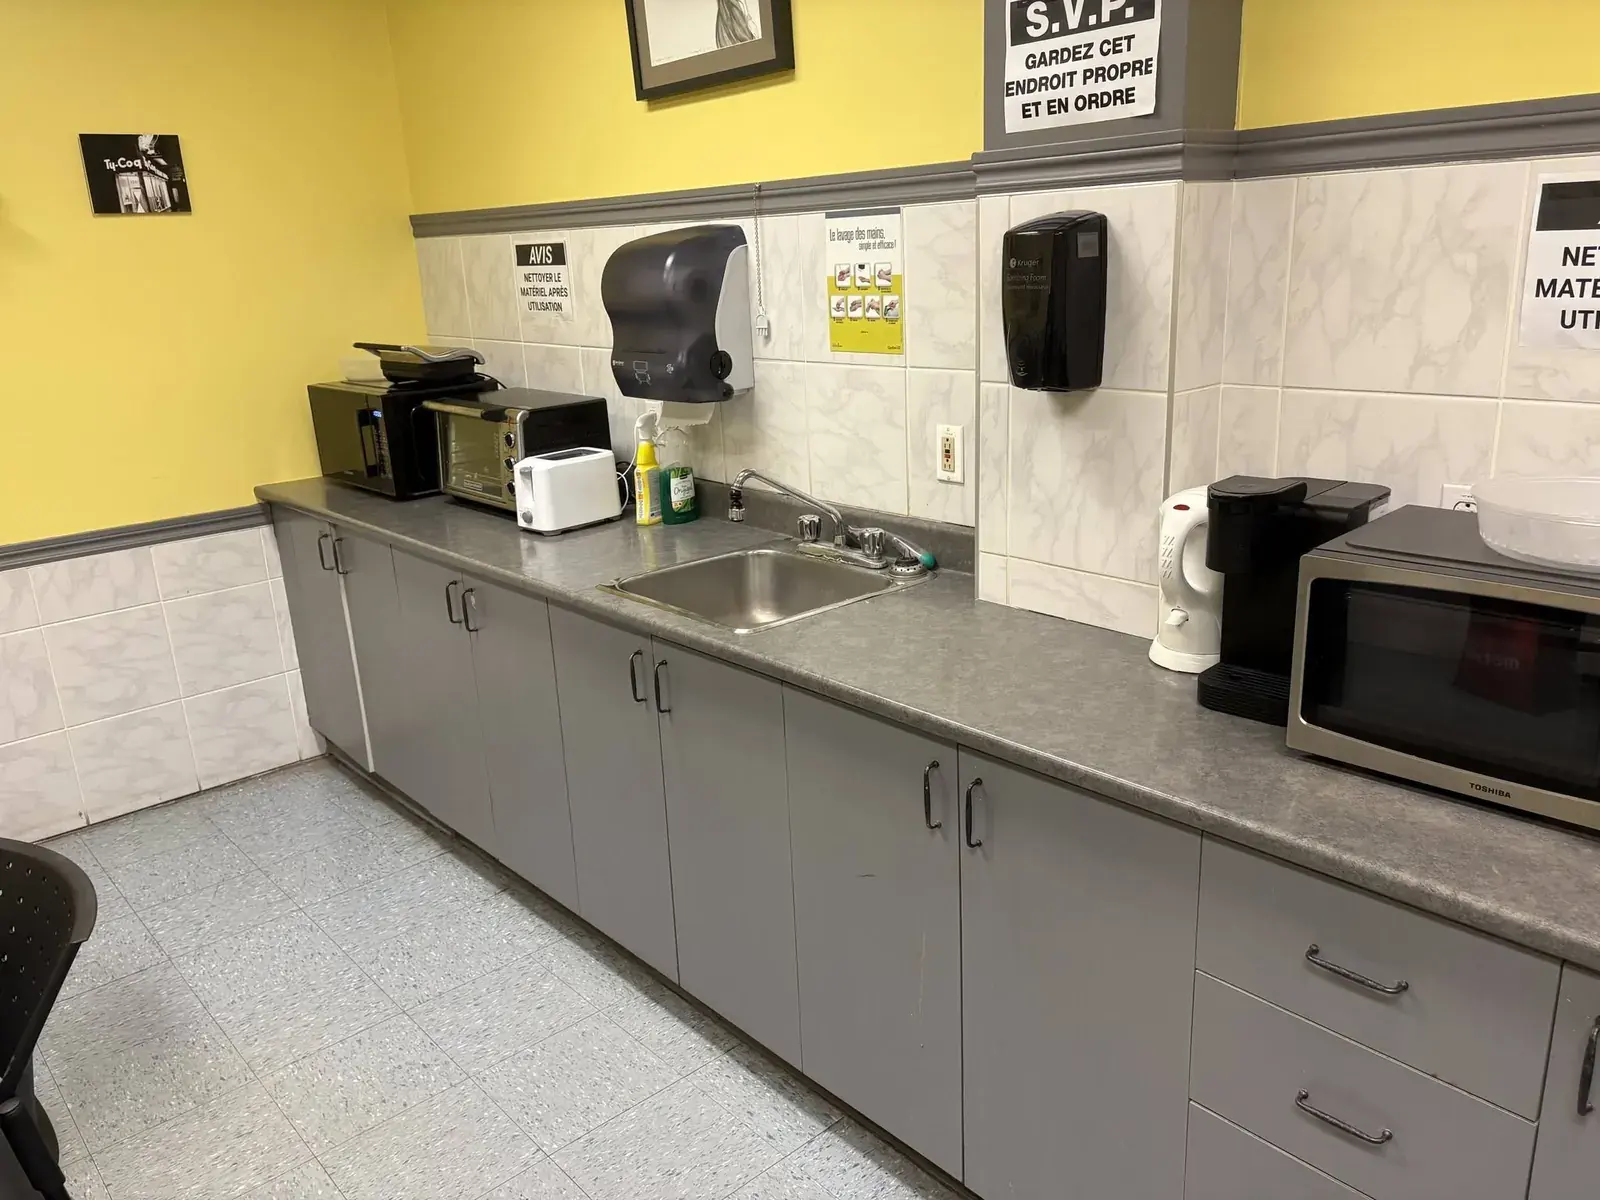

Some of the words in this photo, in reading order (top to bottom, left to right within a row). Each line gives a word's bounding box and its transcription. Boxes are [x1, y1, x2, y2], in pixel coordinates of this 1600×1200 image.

[1025, 0, 1135, 38] S.V.P.
[1025, 42, 1095, 70] GARDEZ
[1099, 34, 1136, 57] CET
[1005, 71, 1078, 98] ENDROIT
[1082, 57, 1154, 86] PROPRE
[1021, 101, 1042, 119] ET
[1047, 97, 1069, 116] EN
[1074, 87, 1136, 112] ORDRE
[829, 228, 836, 242] Le
[837, 228, 855, 244] lavage
[855, 226, 866, 240] des
[529, 245, 553, 265] AVIS
[1561, 245, 1600, 267] NE
[523, 272, 553, 283] NETTOYER
[553, 272, 562, 283] LE
[520, 285, 547, 297] MATÉRIEL
[548, 285, 568, 297] APRÈS
[528, 301, 563, 312] UTILISATION
[1469, 781, 1512, 799] TOSHIBA
